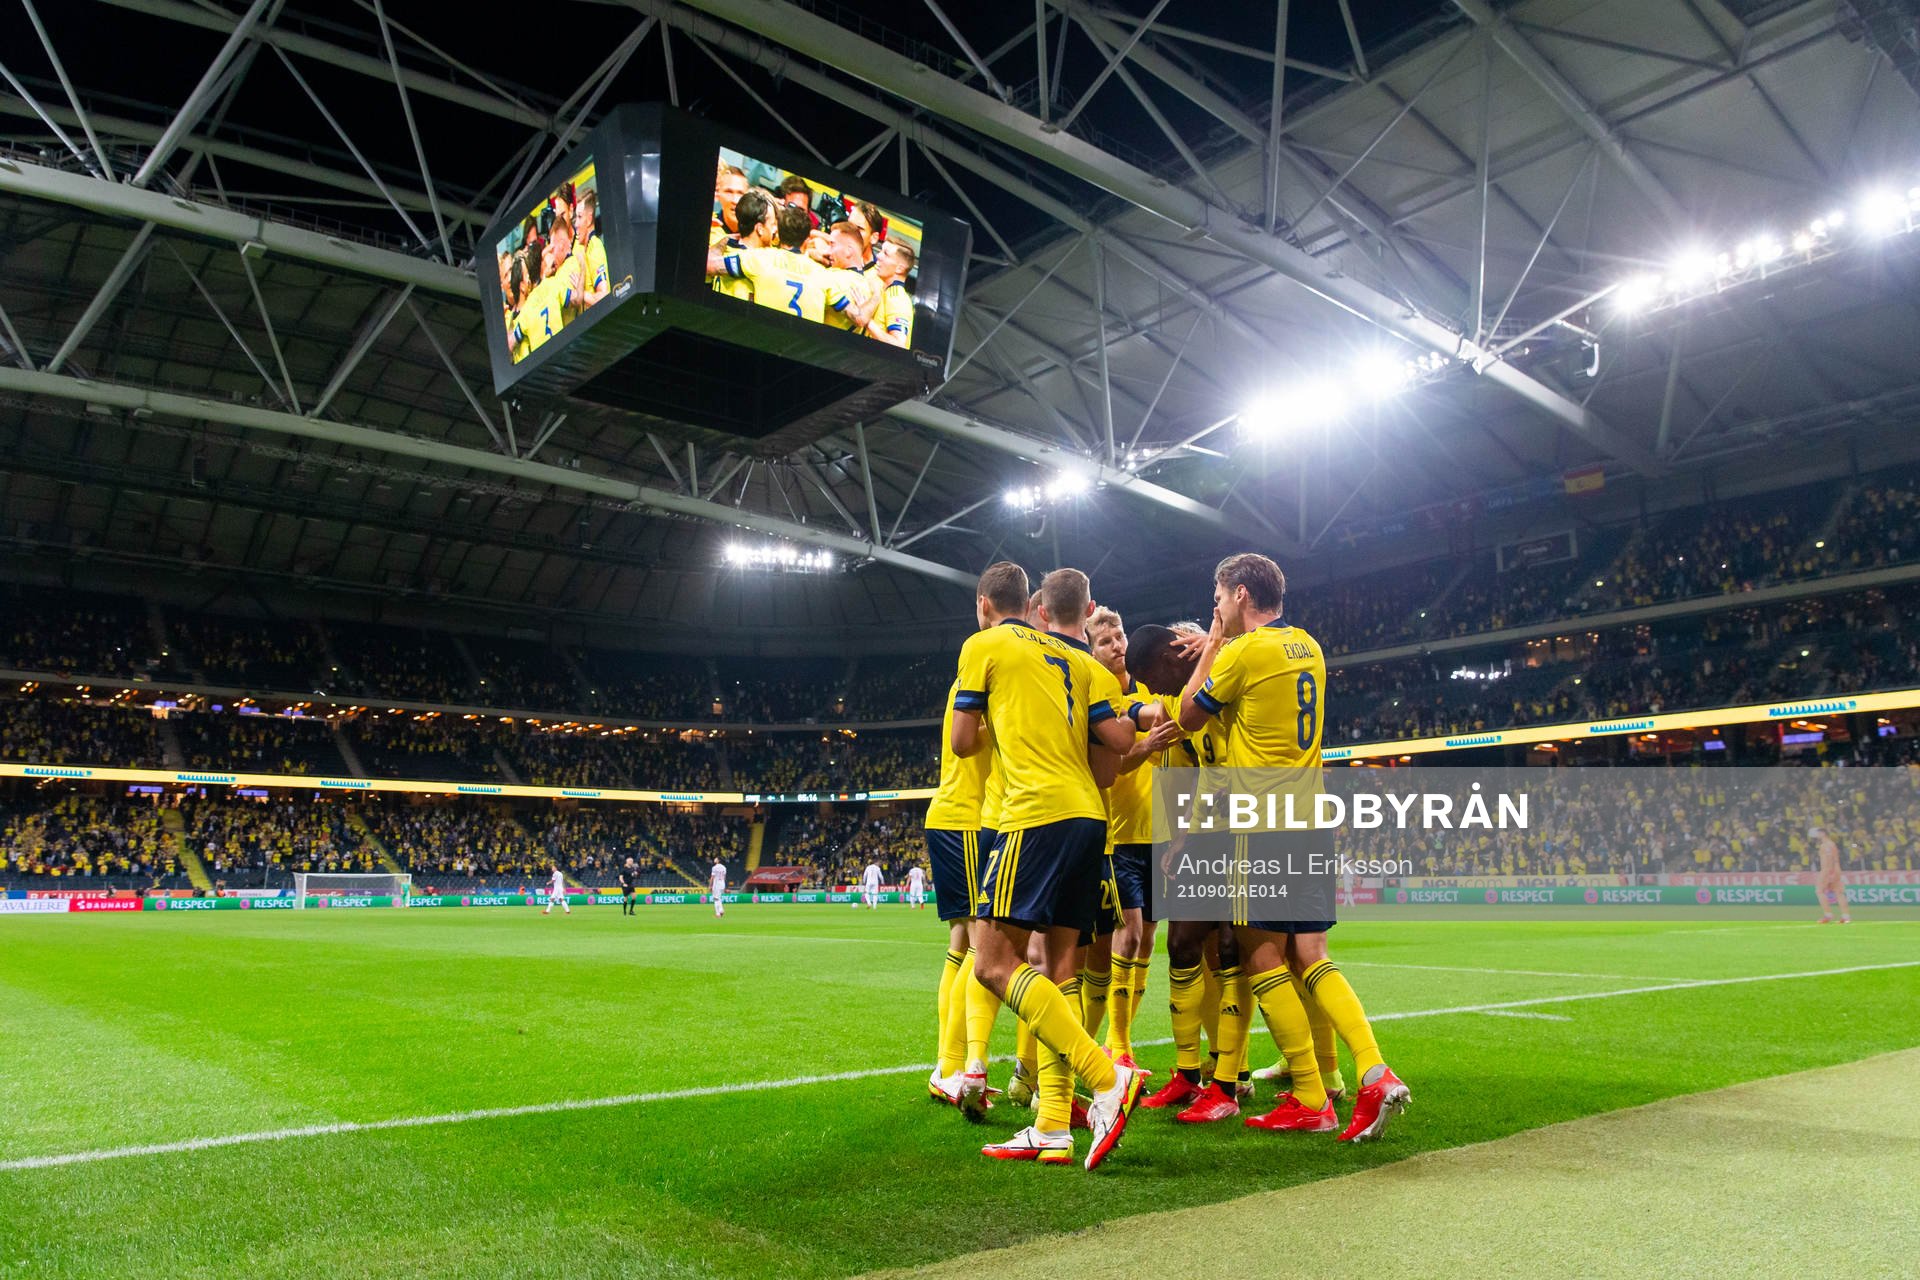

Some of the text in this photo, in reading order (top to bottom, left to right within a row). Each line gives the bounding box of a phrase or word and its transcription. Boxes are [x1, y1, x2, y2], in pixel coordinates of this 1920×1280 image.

[1283, 642, 1315, 660] EKDAL
[1043, 653, 1075, 728] 7
[1296, 671, 1317, 751] 8
[983, 849, 1000, 888] 7
[598, 896, 625, 904] RESPEC
[654, 895, 685, 903] RESPECT
[1411, 890, 1459, 901] RESPECT
[1501, 890, 1555, 902] RESPECT
[1602, 889, 1662, 902] RESPECT
[1717, 888, 1784, 902] RESPECT
[86, 901, 136, 910] BAUHAUS
[170, 900, 217, 909] RESPECT
[254, 899, 297, 908] RESPECT
[331, 898, 372, 907] RESPECT
[410, 897, 442, 906] ESPECT
[473, 897, 508, 905] RESPECT
